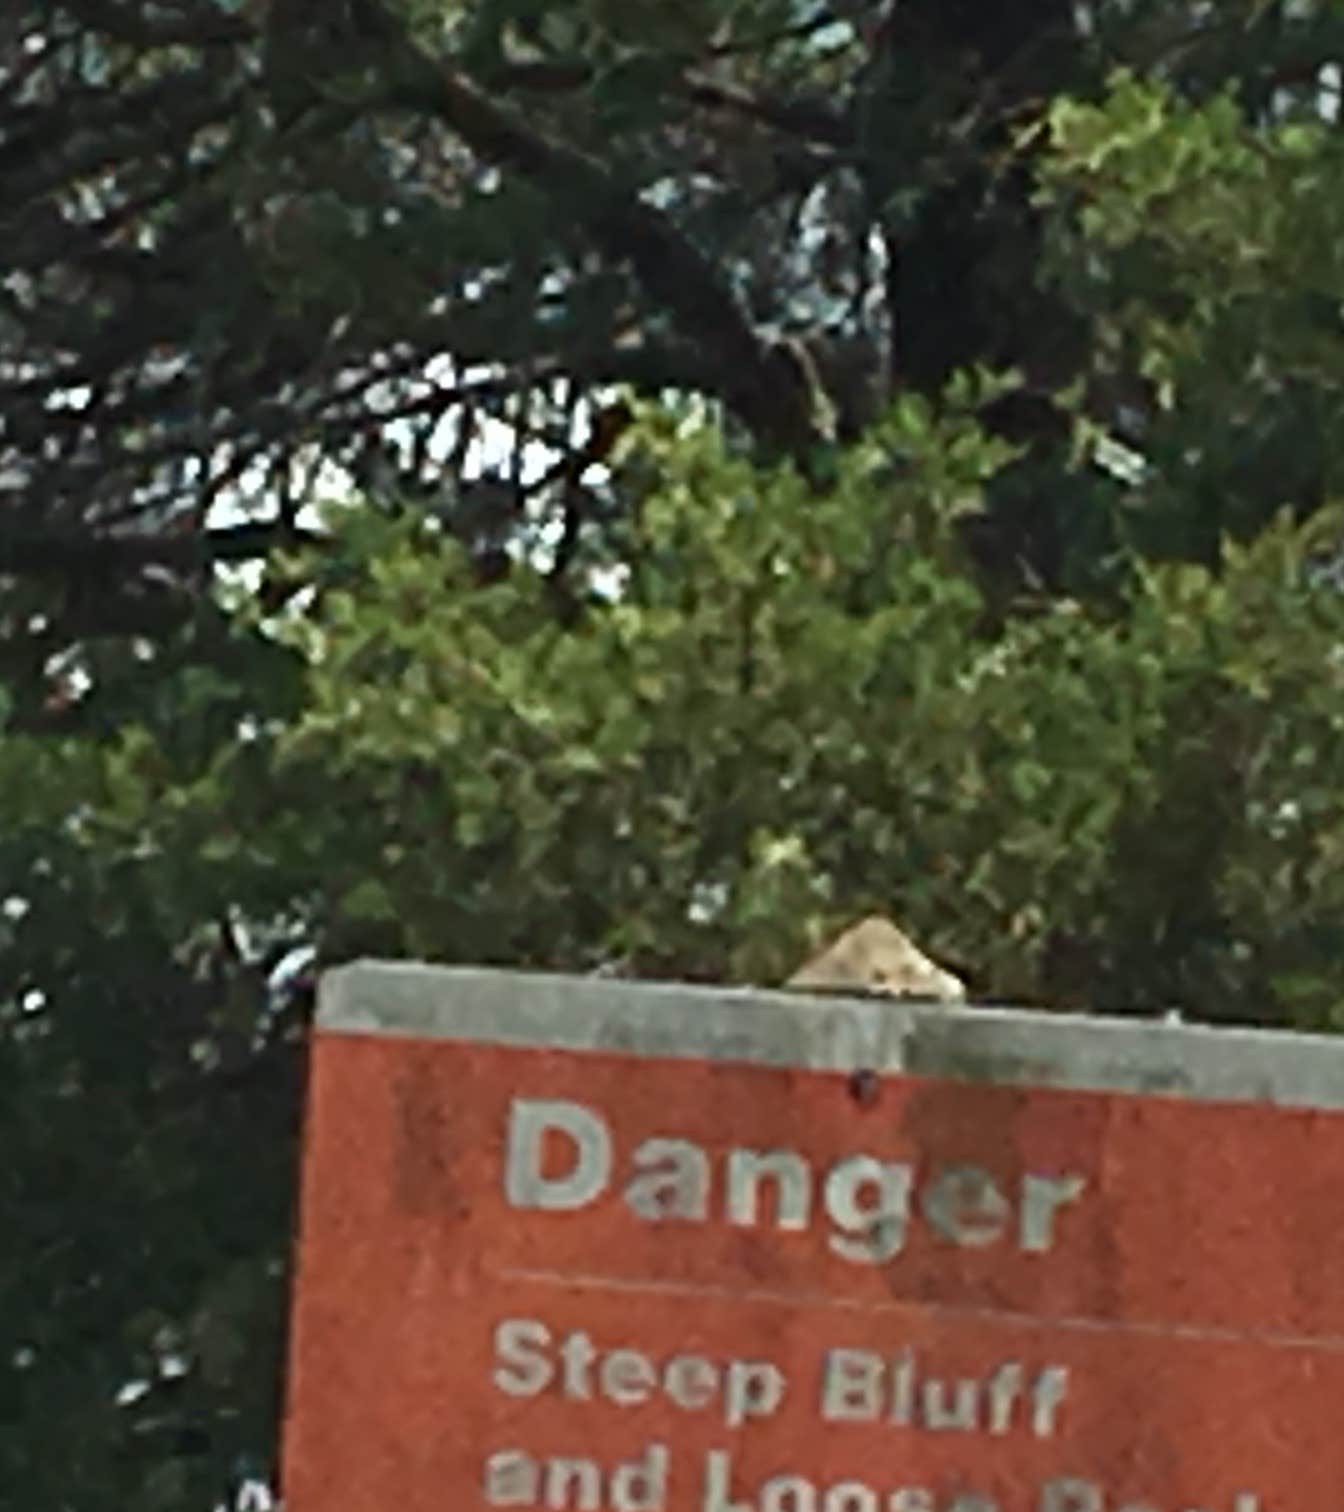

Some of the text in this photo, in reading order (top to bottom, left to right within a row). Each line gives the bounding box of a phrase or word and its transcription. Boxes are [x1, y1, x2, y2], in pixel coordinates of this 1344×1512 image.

[504, 1098, 1084, 1262] Danger
[493, 1319, 1071, 1438] Steep Bluff
